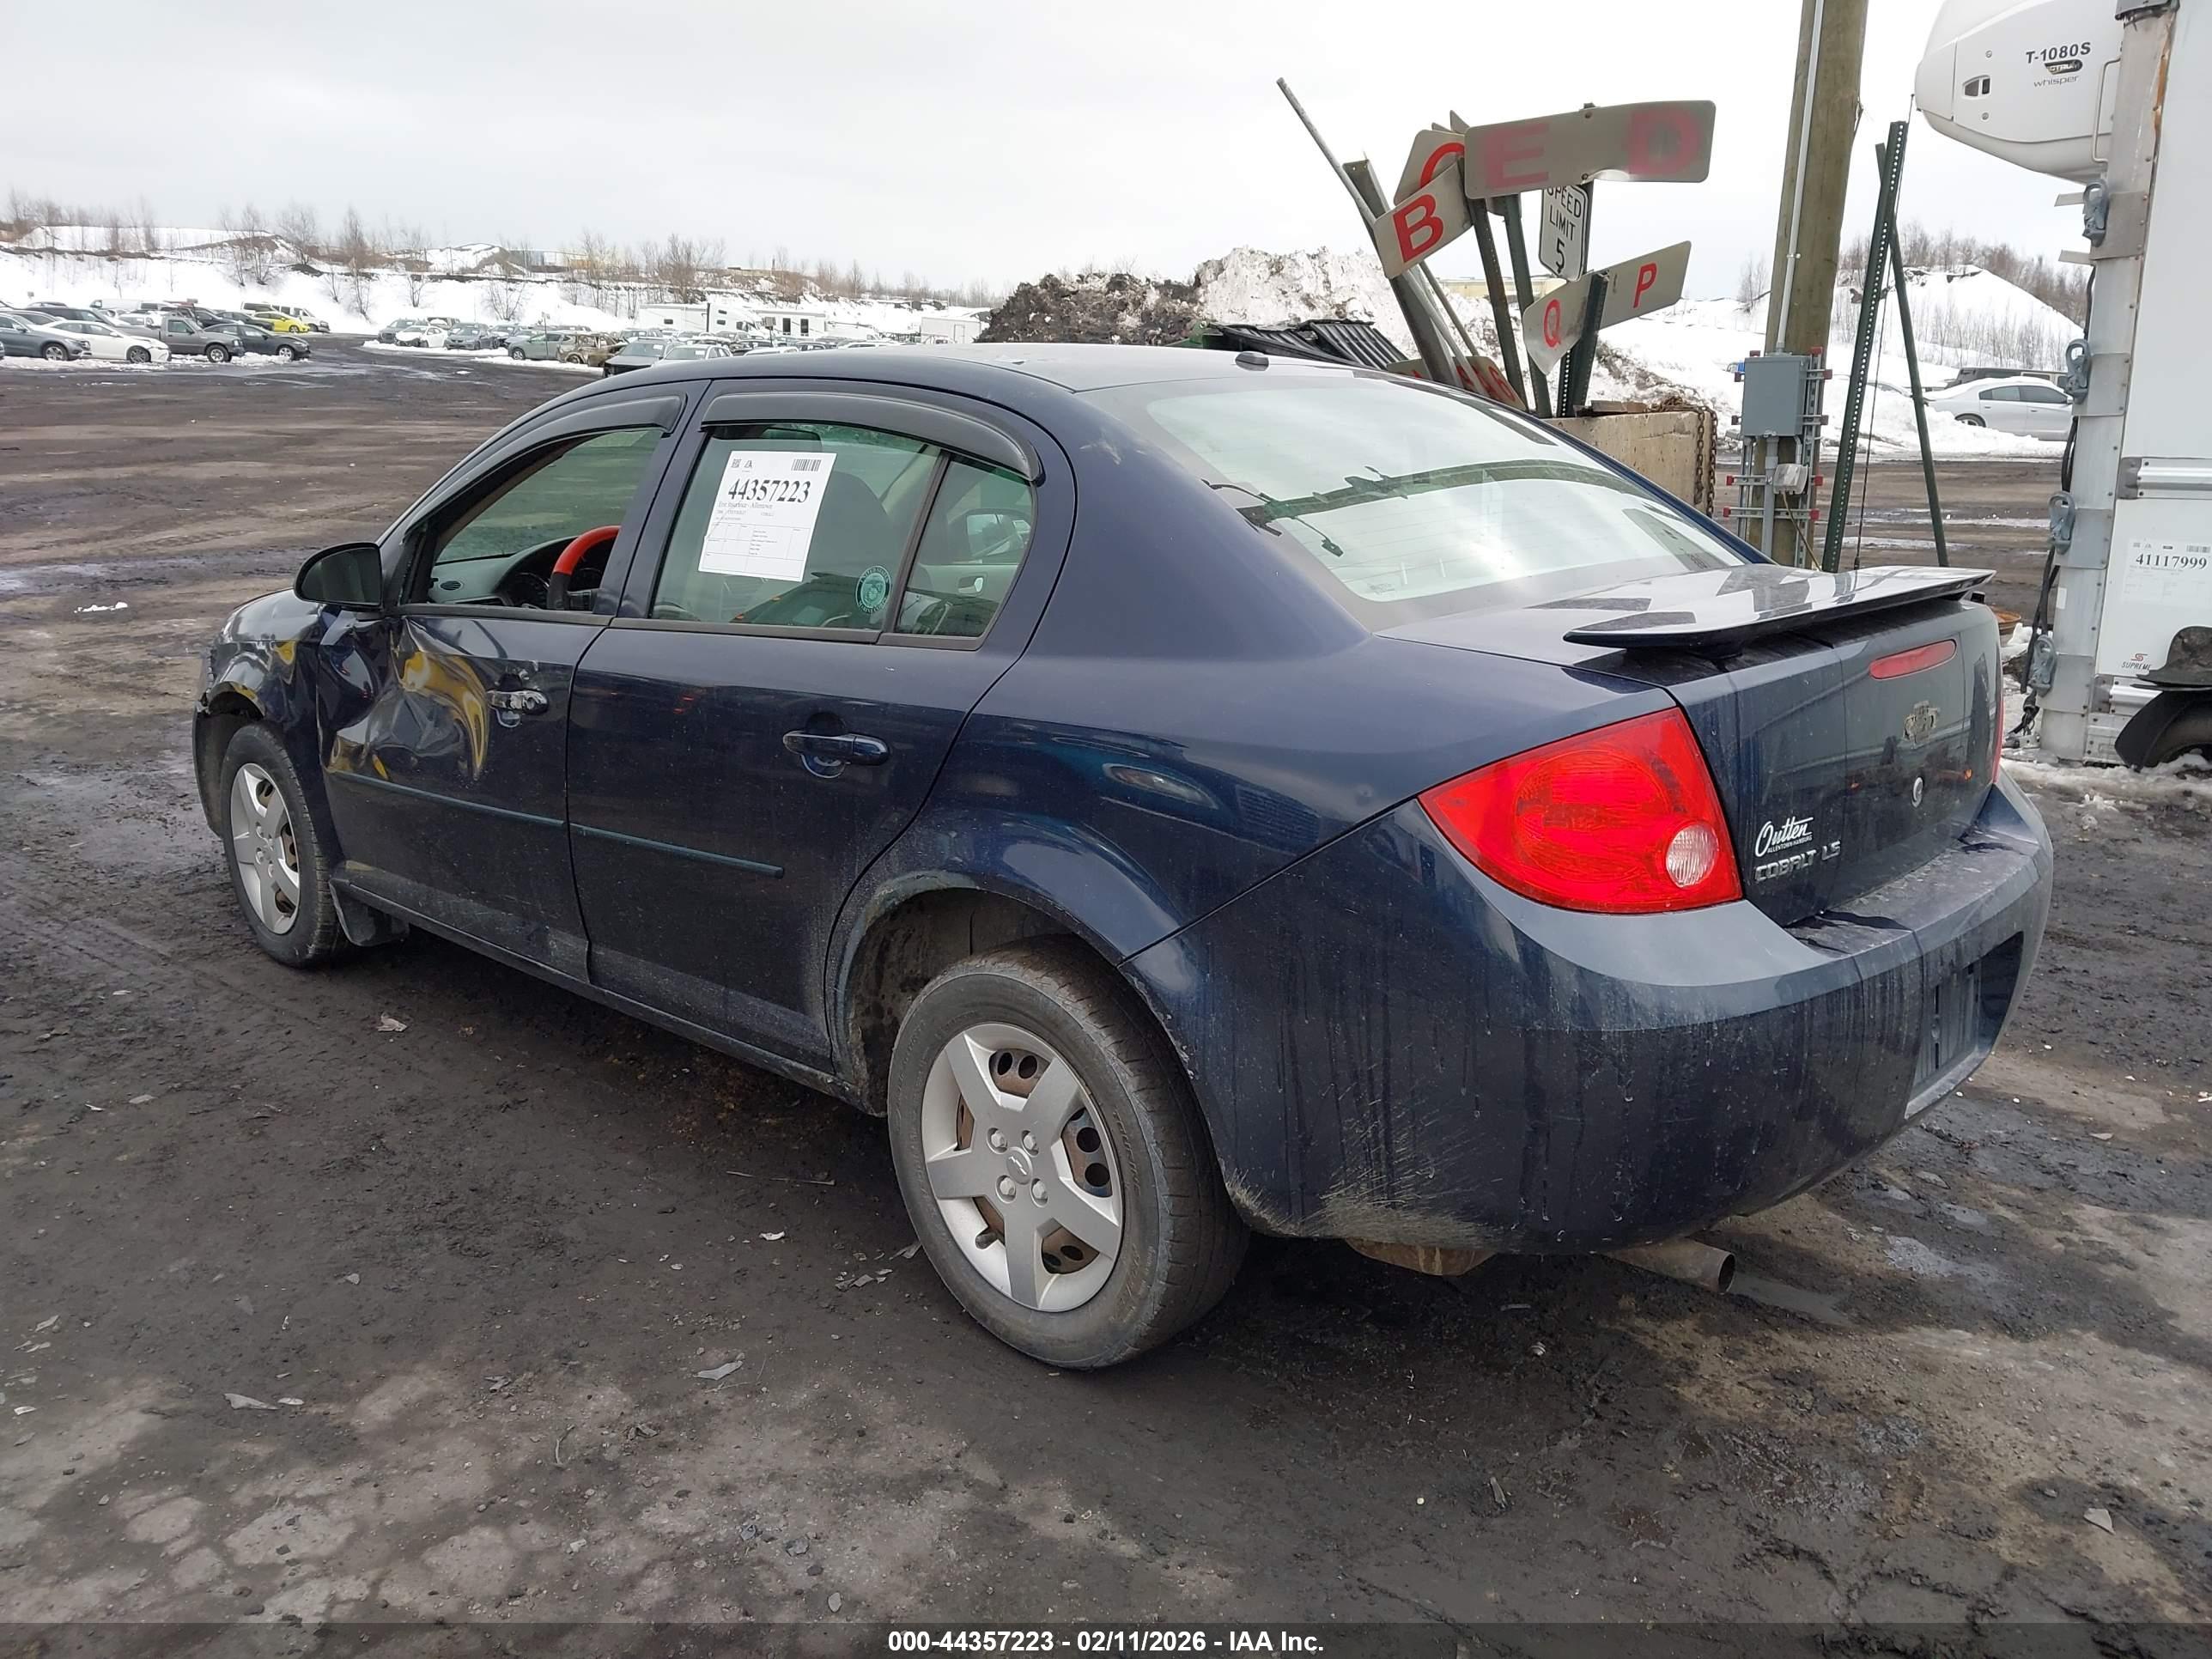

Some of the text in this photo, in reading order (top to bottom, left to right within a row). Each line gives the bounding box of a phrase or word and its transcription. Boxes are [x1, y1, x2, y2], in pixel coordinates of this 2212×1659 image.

[2026, 41, 2091, 64] T-1080S
[2034, 76, 2078, 87] whisper
[1486, 123, 1549, 187] E
[1626, 106, 1700, 176] D
[1393, 194, 1443, 263] B
[1549, 204, 1576, 240] LIMIT
[1556, 237, 1565, 274] 5
[1633, 263, 1657, 308] P
[727, 478, 811, 503] 44357223
[2136, 553, 2208, 569] 41117999
[1754, 816, 1814, 857] Outten
[1754, 840, 1840, 882] COBALT LS
